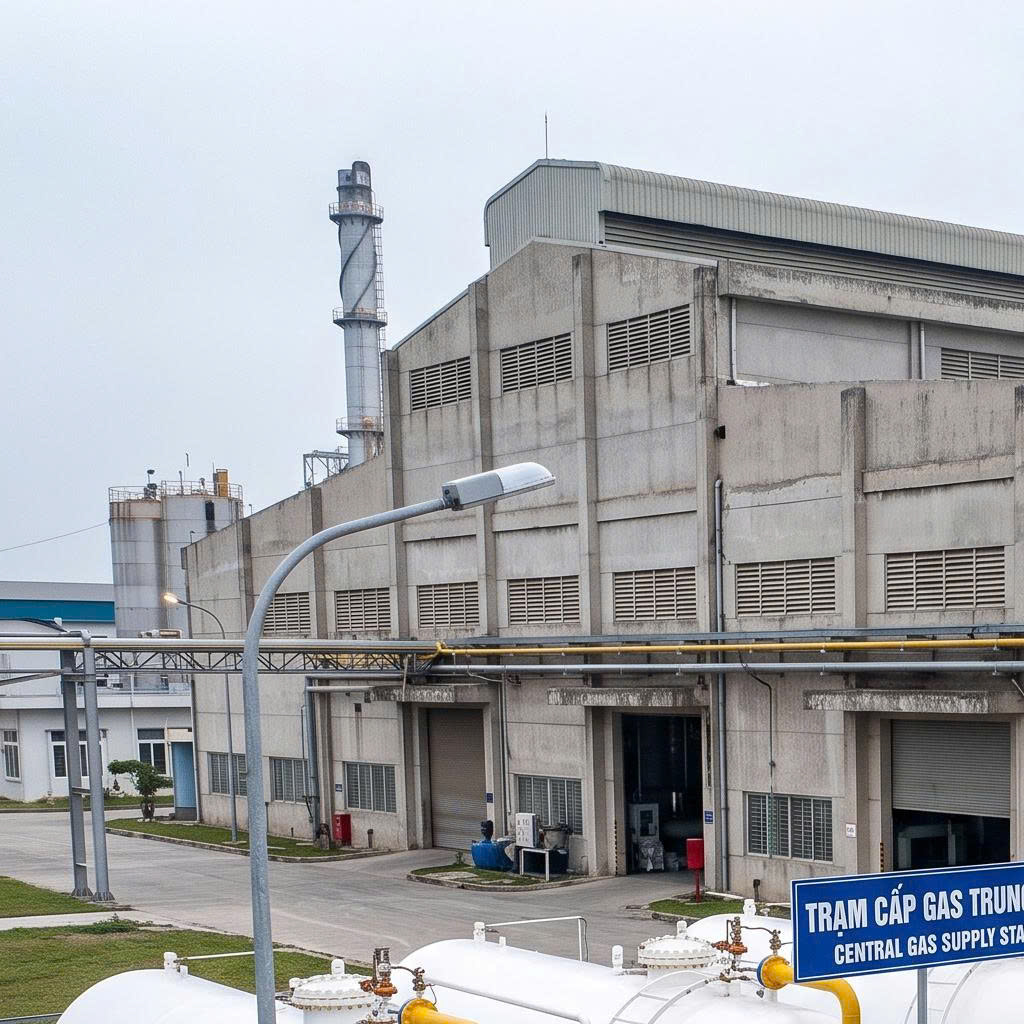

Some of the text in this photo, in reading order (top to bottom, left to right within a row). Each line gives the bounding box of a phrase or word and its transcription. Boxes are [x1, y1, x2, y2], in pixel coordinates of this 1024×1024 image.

[805, 898, 868, 937] TRẠM
[874, 883, 917, 927] CẤP
[923, 889, 964, 921] GAS
[834, 940, 903, 965] CENTRAL
[907, 935, 938, 957] GAS
[941, 927, 996, 952] SUPPLY
